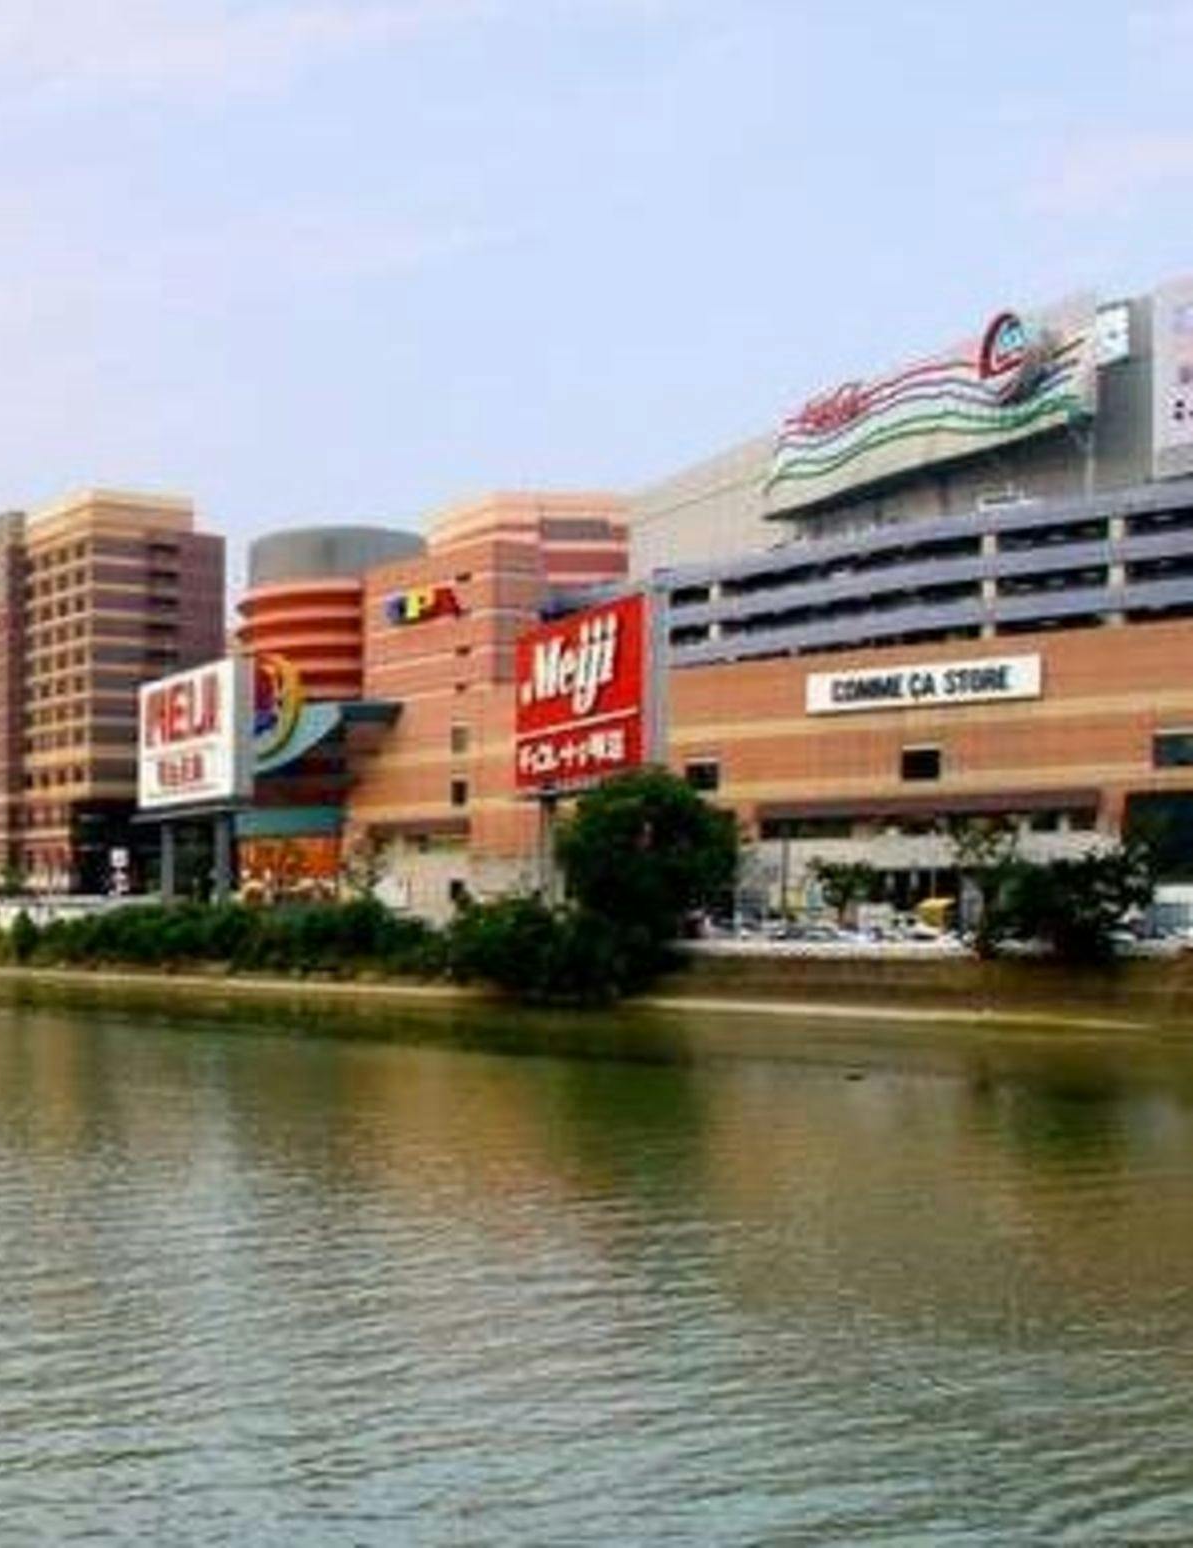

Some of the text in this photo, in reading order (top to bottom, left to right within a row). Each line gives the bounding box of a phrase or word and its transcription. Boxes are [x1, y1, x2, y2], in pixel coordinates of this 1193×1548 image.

[520, 611, 618, 715] Meiji
[831, 672, 904, 702] COMME
[942, 664, 1010, 695] STORE
